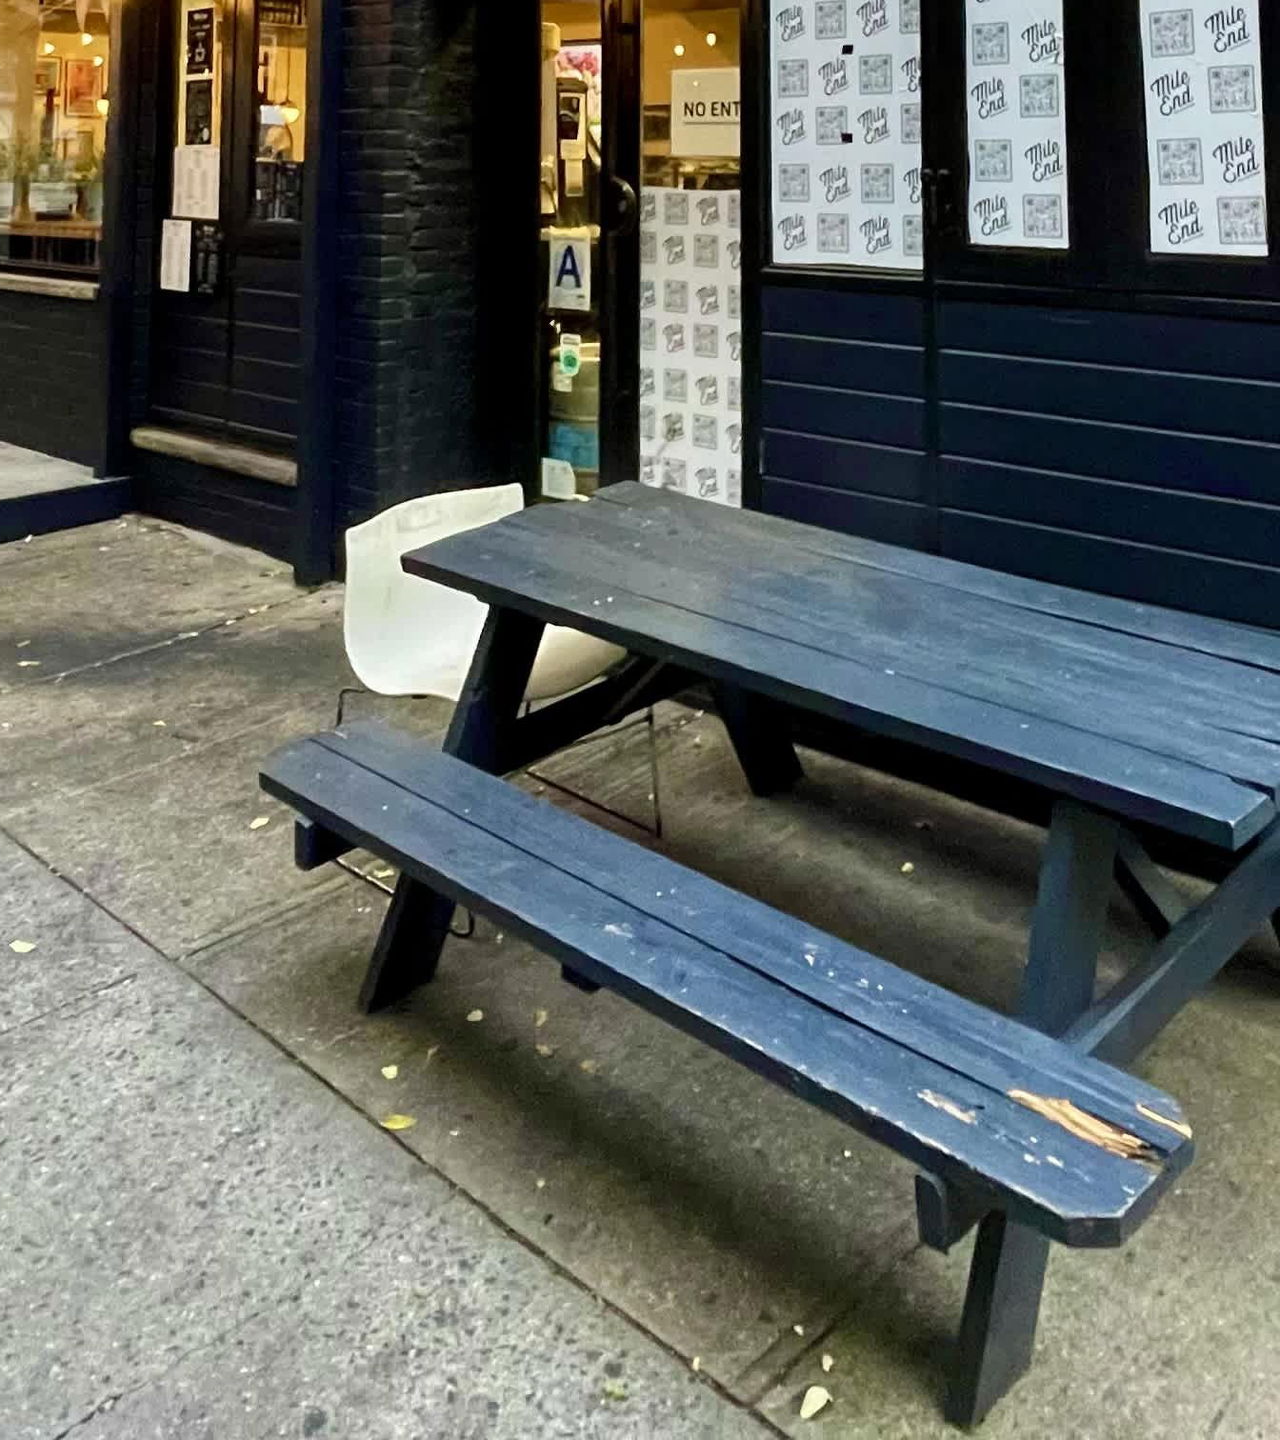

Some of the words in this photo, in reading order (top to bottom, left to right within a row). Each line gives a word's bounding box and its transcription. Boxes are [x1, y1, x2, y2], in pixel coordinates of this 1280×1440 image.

[1021, 20, 1056, 45] Mile
[1204, 6, 1247, 35] Mile
[1029, 36, 1059, 63] End
[1214, 25, 1249, 53] End
[971, 77, 1004, 101] Mile
[1151, 70, 1190, 98] Mile
[684, 101, 706, 117] NO
[978, 93, 1006, 119] End
[1160, 86, 1195, 116] End
[1025, 139, 1059, 165] Mile
[1213, 137, 1255, 164] Mile
[1032, 155, 1062, 182] End
[1223, 152, 1259, 183] End
[974, 195, 1007, 219] Mile
[1158, 199, 1200, 226] Mile
[981, 211, 1010, 236] End
[1168, 215, 1202, 245] End
[555, 244, 582, 289] A
